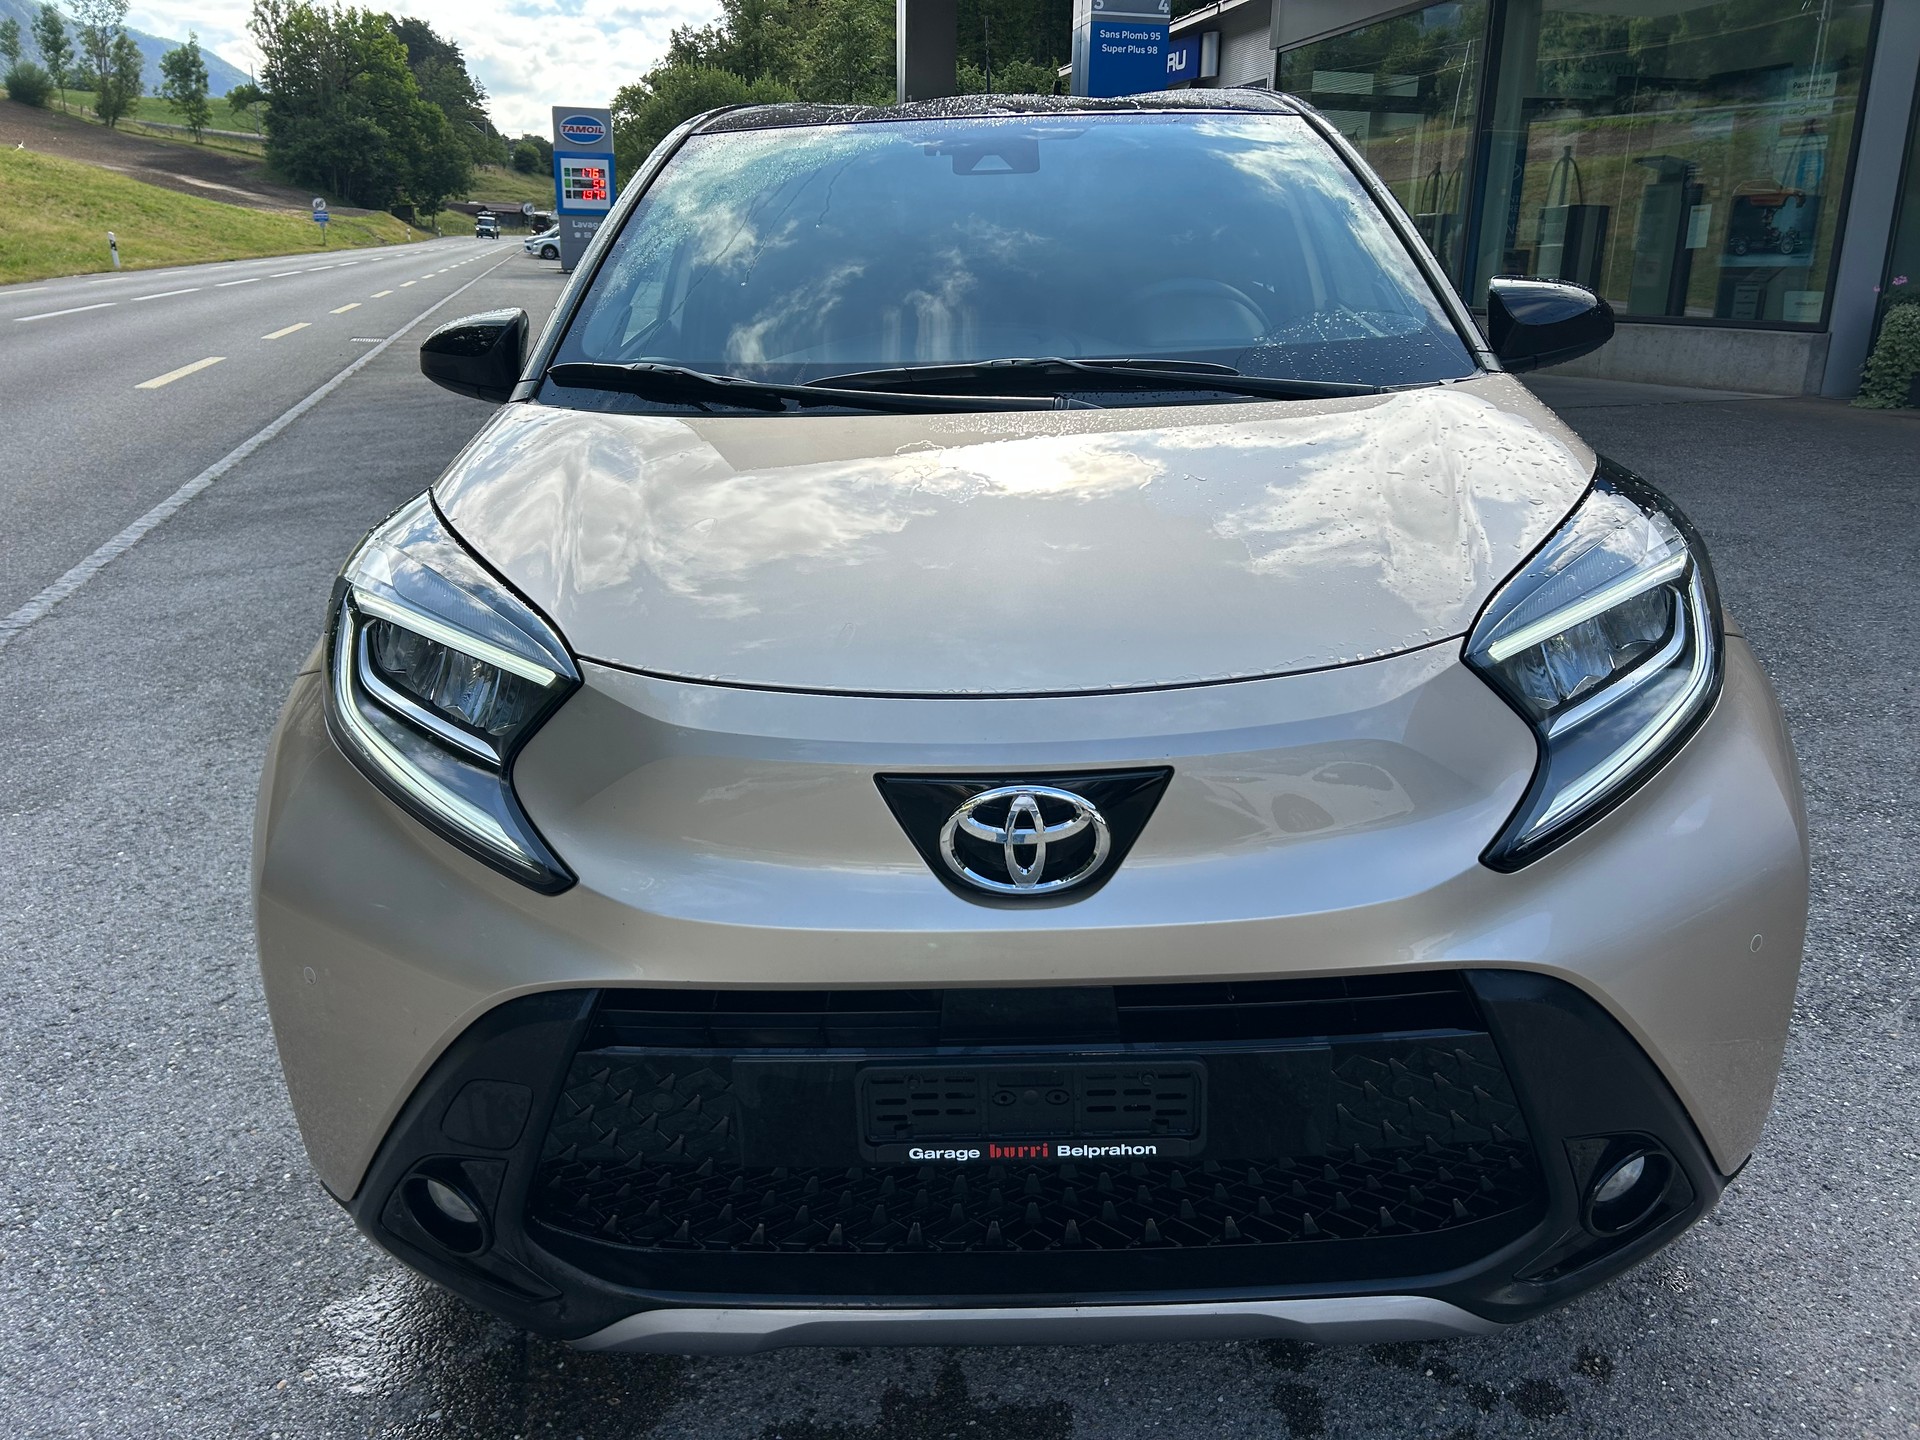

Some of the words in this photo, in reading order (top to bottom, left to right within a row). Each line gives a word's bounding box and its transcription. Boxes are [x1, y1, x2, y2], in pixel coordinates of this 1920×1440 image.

[1100, 29, 1120, 38] Sans
[1121, 30, 1149, 40] Plomb
[1150, 31, 1161, 41] 95
[1101, 43, 1126, 54] Super
[1127, 44, 1146, 54] Plus
[1147, 45, 1158, 55] 98
[561, 125, 604, 134] TAMOIL
[572, 220, 600, 230] Lavag
[909, 1148, 980, 1161] Garage
[989, 1142, 1049, 1159] burri
[1057, 1144, 1157, 1158] Belprahon
